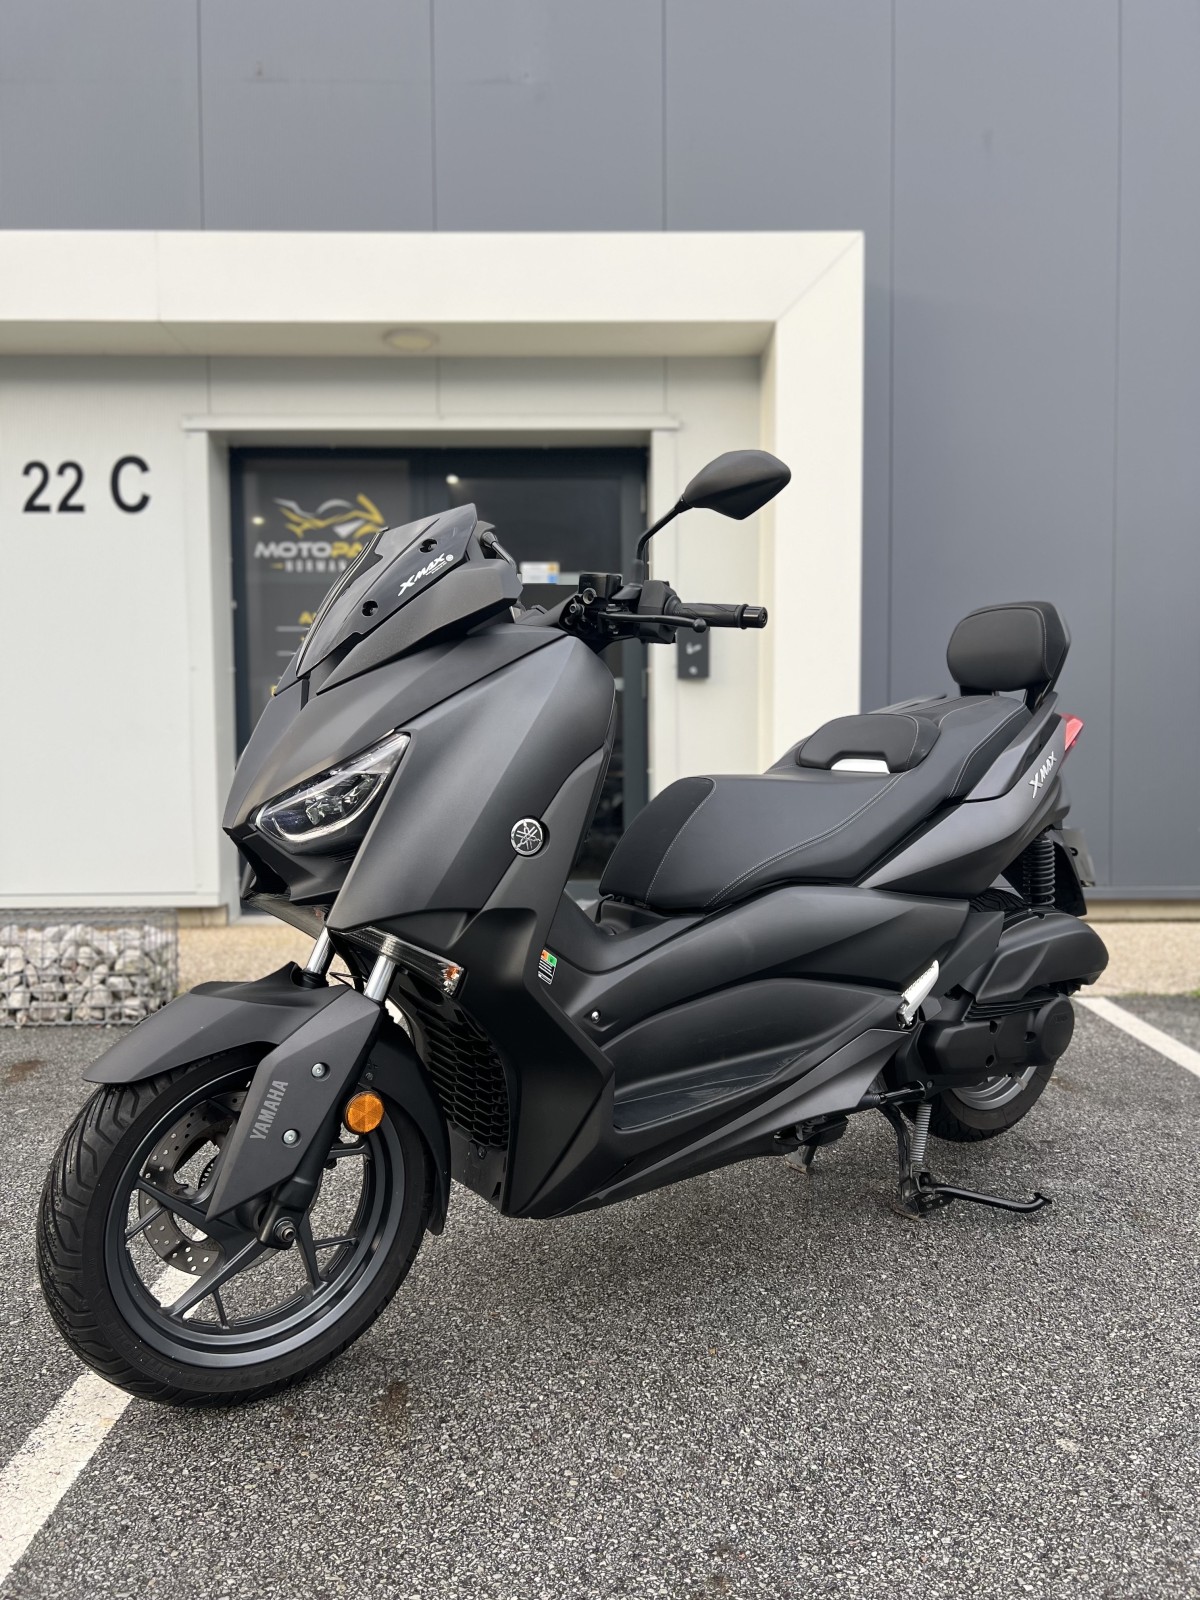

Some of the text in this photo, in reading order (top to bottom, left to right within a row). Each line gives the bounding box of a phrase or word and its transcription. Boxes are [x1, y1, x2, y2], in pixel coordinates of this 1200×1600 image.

[22, 454, 151, 515] 22 C
[249, 1080, 289, 1140] YAMAHA
